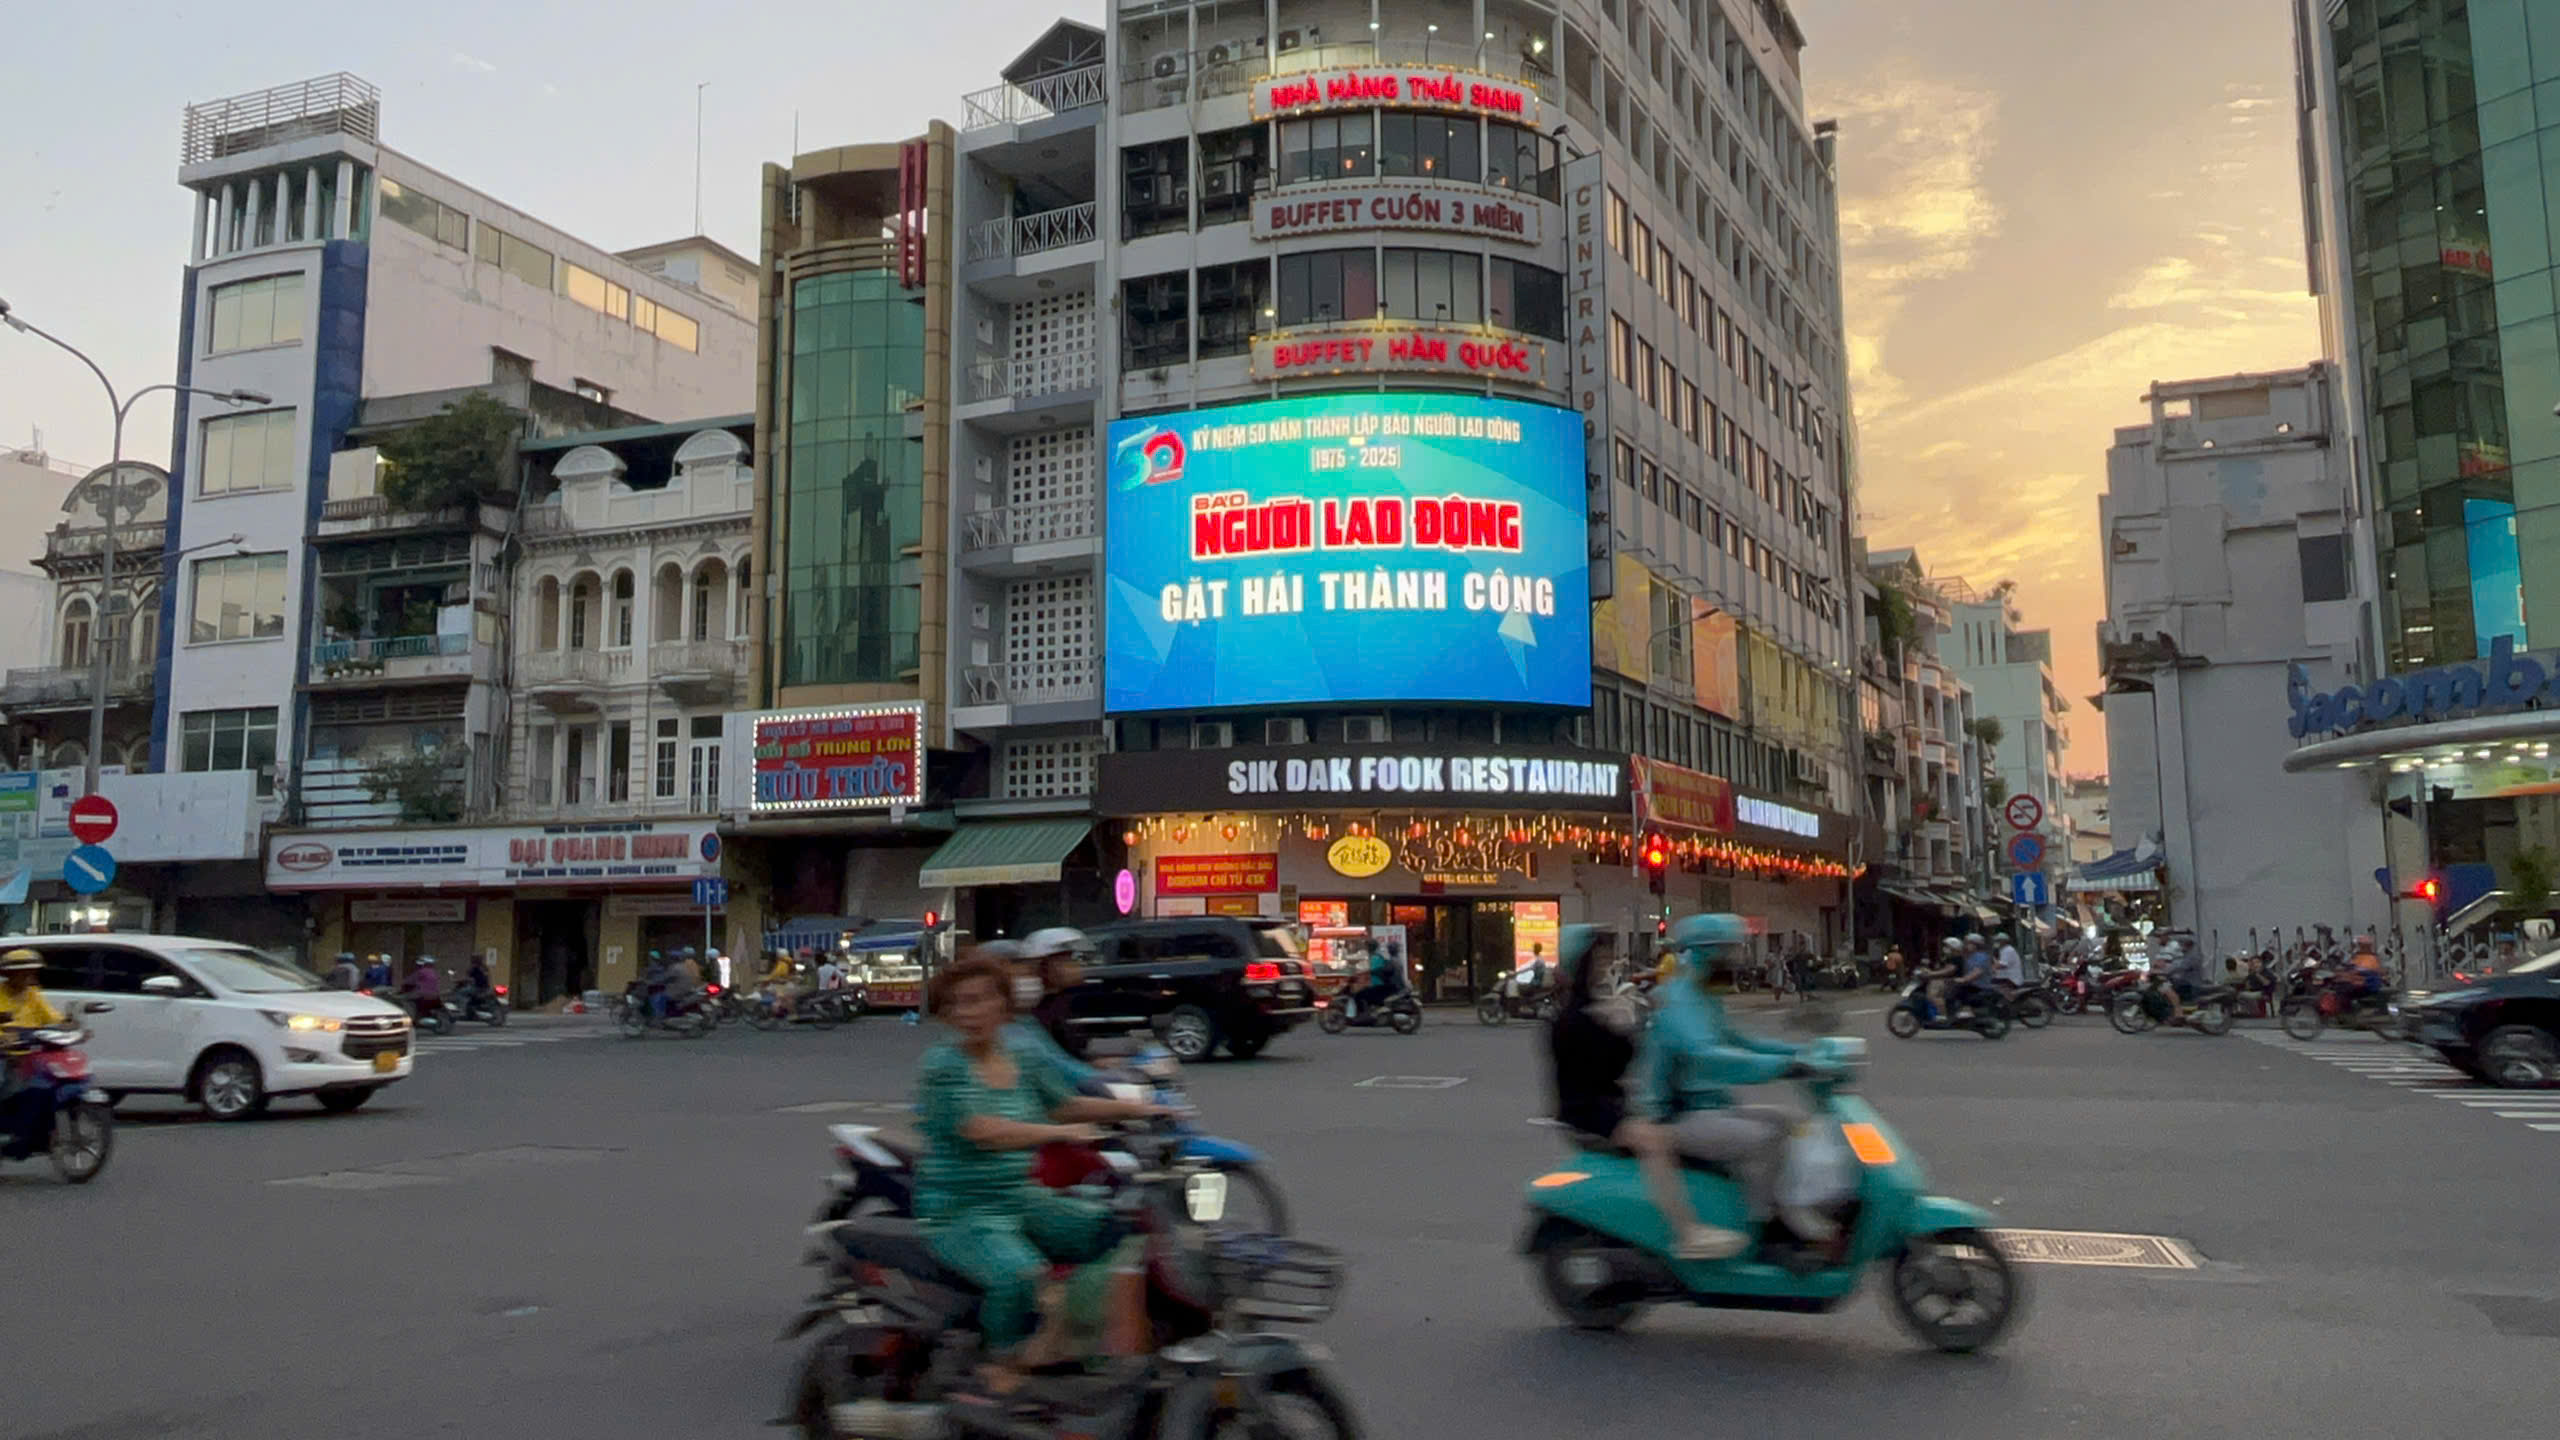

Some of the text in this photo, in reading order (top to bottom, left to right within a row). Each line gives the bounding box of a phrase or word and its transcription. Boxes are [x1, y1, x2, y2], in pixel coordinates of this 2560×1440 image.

[1271, 72, 1523, 114] NHÀ HÀNG THÁI SIAM
[1271, 192, 1524, 234] BUFFET CUỐN 3 MIỀN
[1577, 185, 1595, 376] CENTRAL
[1274, 332, 1530, 372] BUFFET HÀN QUỐC
[1213, 424, 1247, 451] NIỆM
[1250, 425, 1266, 445] 50
[1270, 417, 1301, 442] NĂM
[1306, 413, 1350, 438] THÀNH
[1354, 411, 1379, 435] LẬP
[1384, 412, 1410, 435] BÁO
[1414, 411, 1456, 437] NGƯỜI
[1460, 416, 1483, 437] LAO
[1487, 416, 1521, 444] ĐỘNG
[1194, 494, 1247, 510] BÁO
[1194, 496, 1520, 557] NGƯỜI LAO ĐỘNG
[1161, 564, 1554, 627] GẶT HÁI THÀNH CÔNG
[758, 756, 906, 801] HỮU THỨC
[1228, 758, 1279, 794] SIK
[1286, 757, 1352, 793] DAK
[1359, 756, 1445, 793] FOOK
[1451, 756, 1619, 797] RESTAURANT
[551, 836, 626, 863] QUANG
